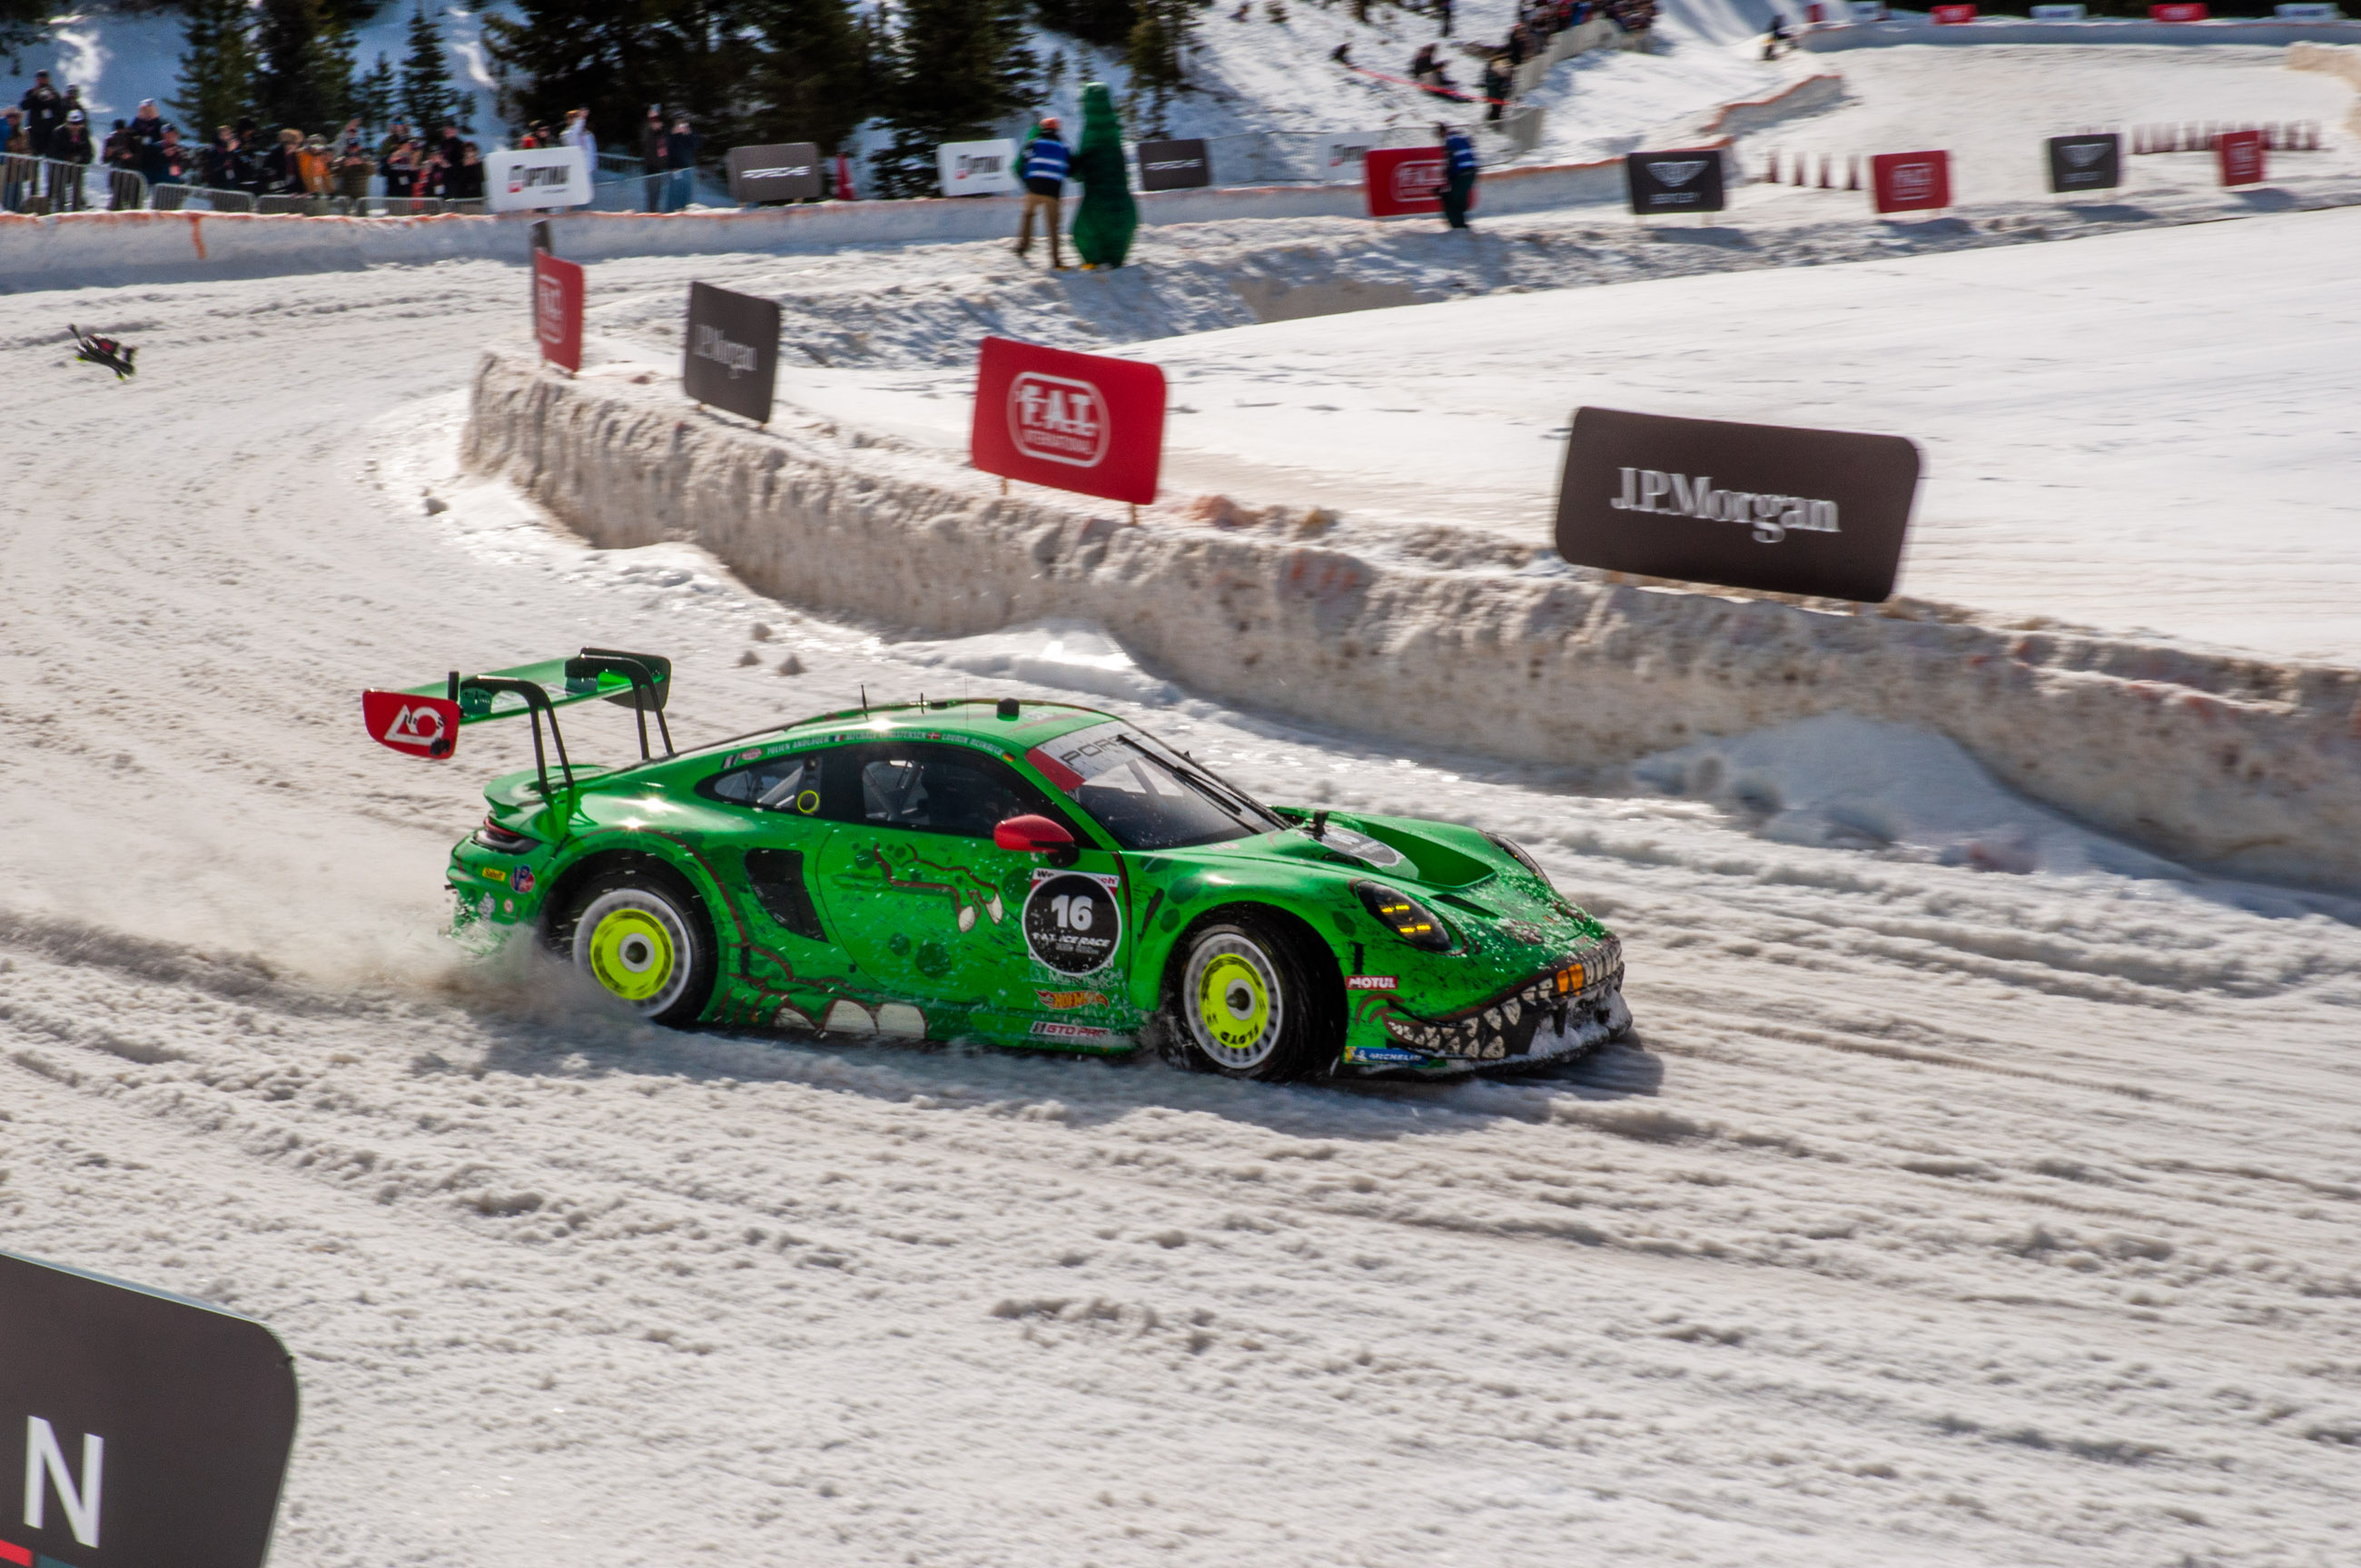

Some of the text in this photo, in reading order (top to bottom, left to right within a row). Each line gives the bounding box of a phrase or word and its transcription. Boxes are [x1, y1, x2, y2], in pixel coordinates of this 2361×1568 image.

[1052, 894, 1093, 932] 16
[1059, 935, 1079, 944] ICE
[1077, 937, 1111, 948] RACE
[1348, 977, 1396, 989] MOTUL
[1046, 1024, 1075, 1035] GTD
